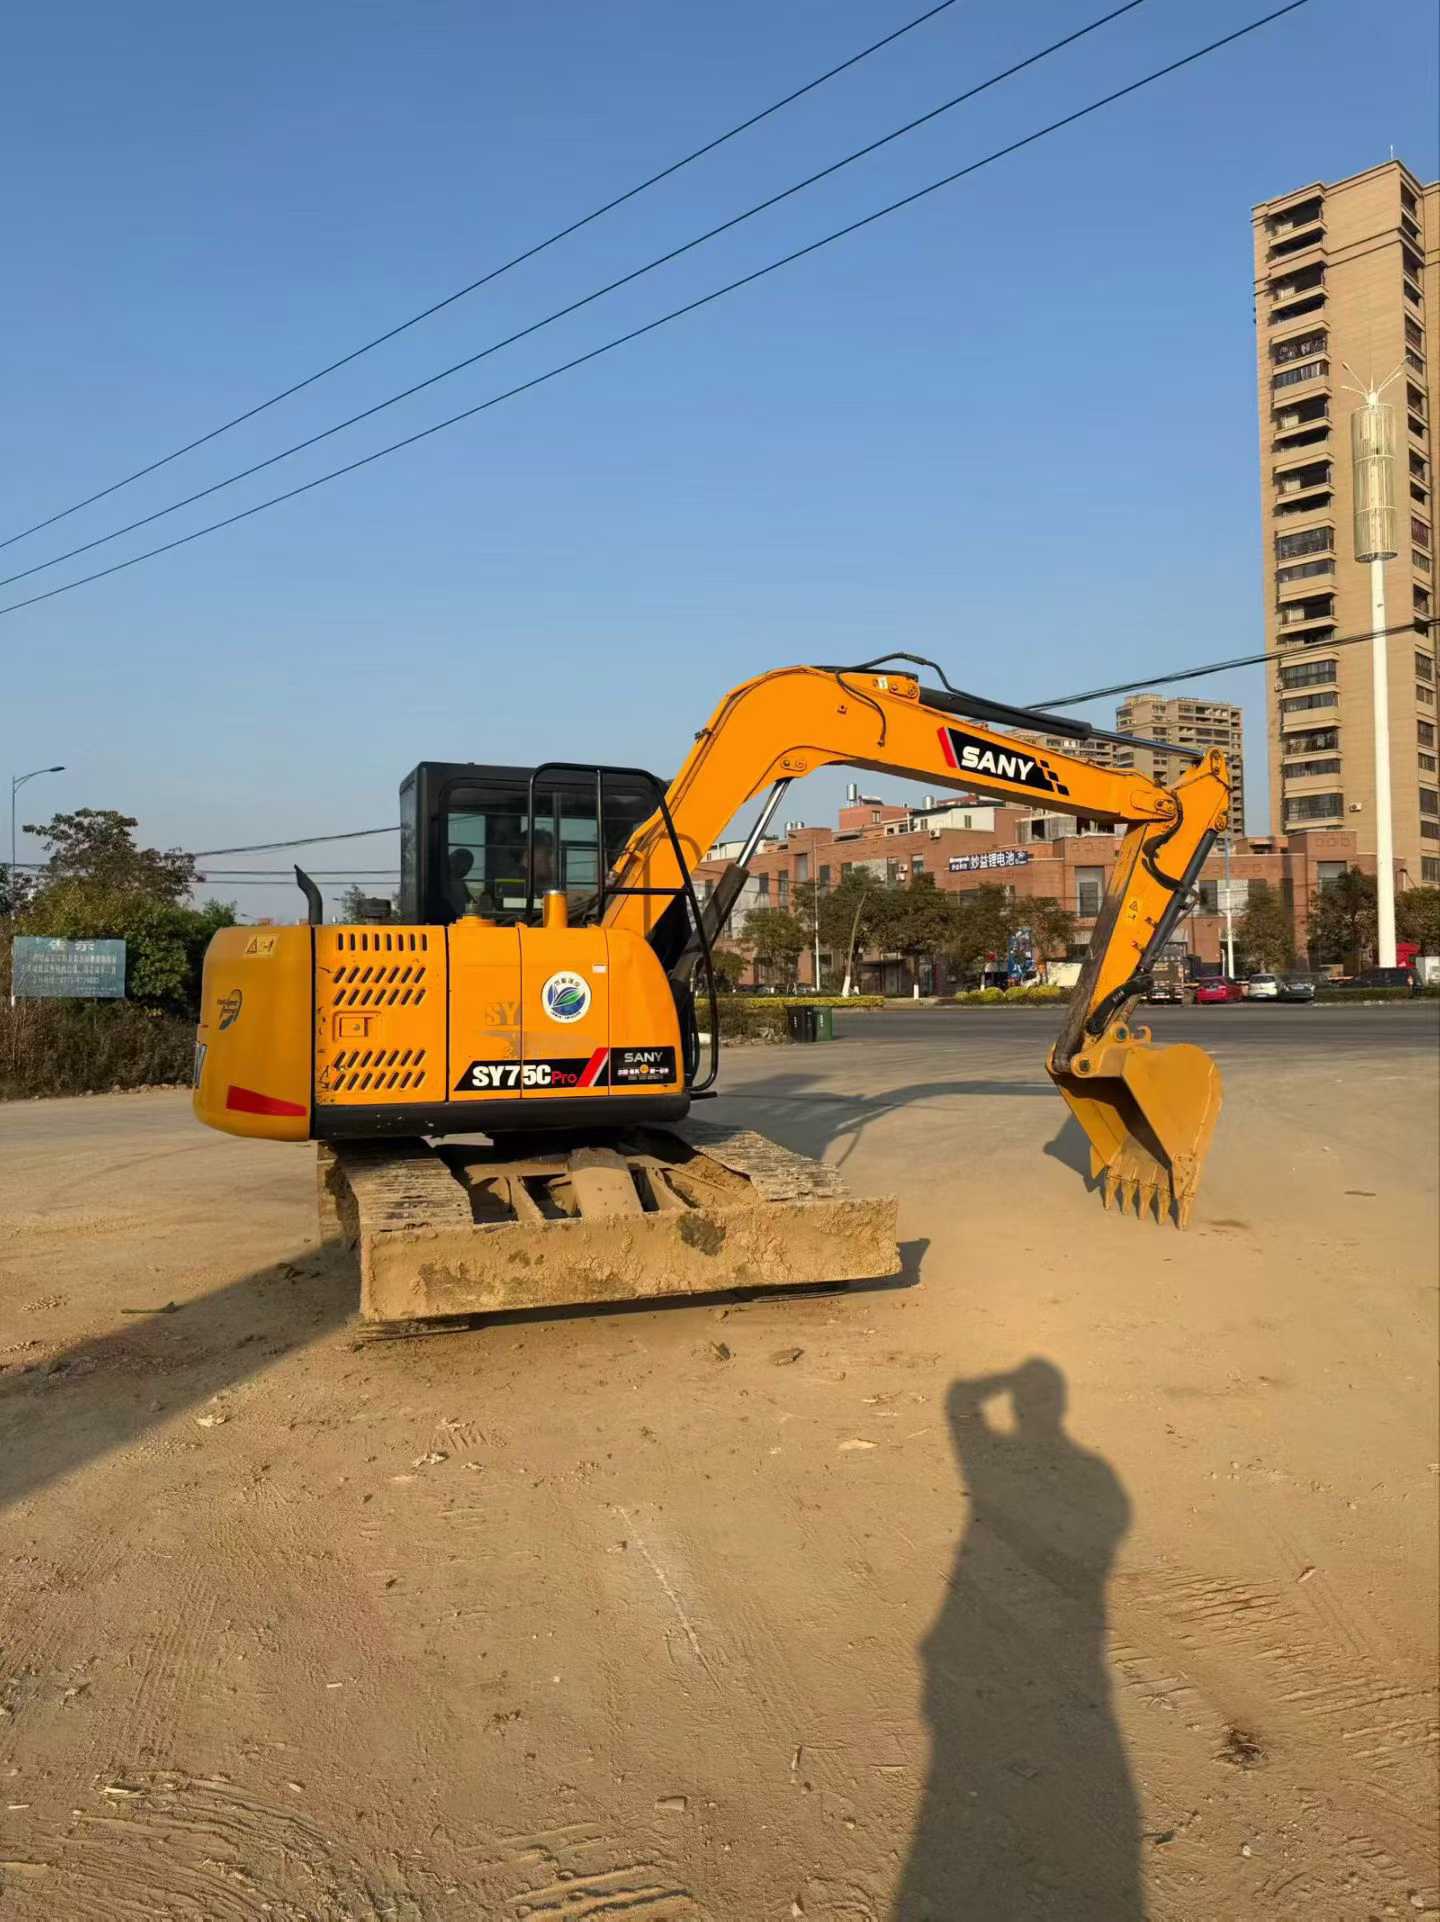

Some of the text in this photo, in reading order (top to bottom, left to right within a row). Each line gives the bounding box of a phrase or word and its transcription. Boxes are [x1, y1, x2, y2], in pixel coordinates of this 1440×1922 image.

[961, 746, 1034, 780] SANY
[624, 1052, 663, 1063] SANY
[472, 1065, 578, 1087] SY75C Pro
